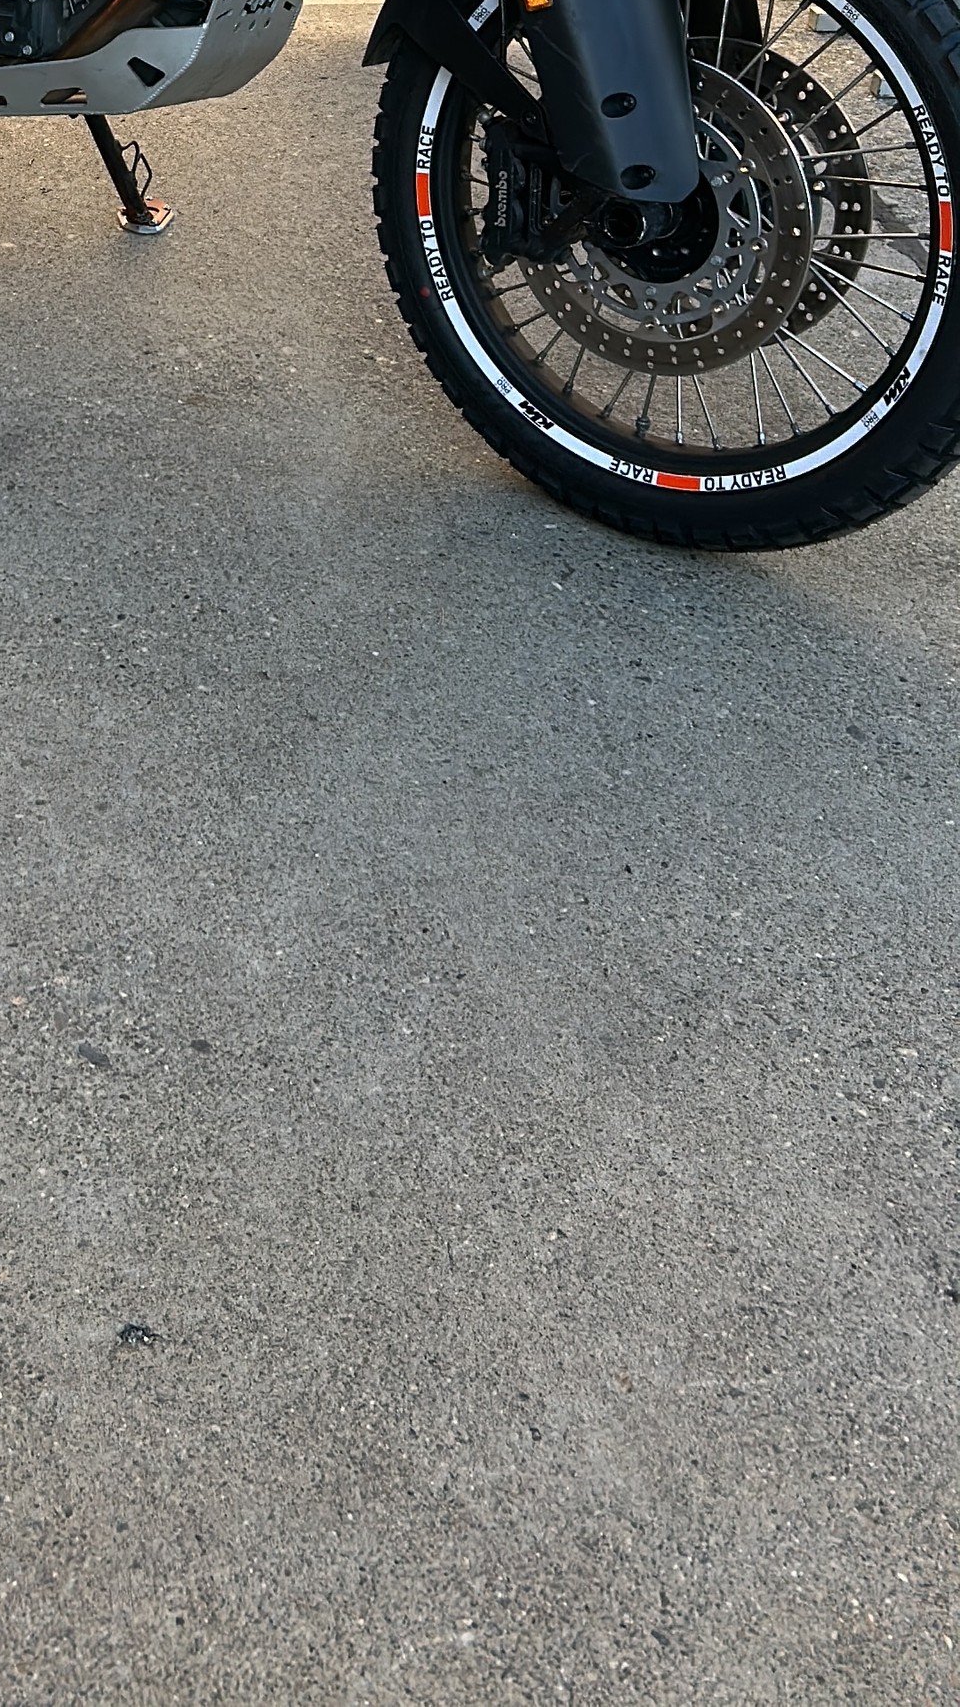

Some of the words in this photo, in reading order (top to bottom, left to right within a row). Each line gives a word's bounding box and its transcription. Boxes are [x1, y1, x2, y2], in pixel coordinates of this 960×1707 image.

[474, 7, 488, 22] PRO
[843, 4, 859, 21] PRO
[417, 125, 436, 169] RACE
[912, 104, 945, 165] READY
[494, 170, 508, 227] brembo
[935, 174, 951, 198] TO
[420, 219, 437, 241] TO
[424, 245, 456, 302] READY
[932, 253, 952, 307] RACE
[496, 378, 511, 394] PRO
[883, 366, 911, 407] KTM
[518, 400, 555, 430] KTM
[863, 412, 879, 428] PRO
[608, 456, 654, 484] RACE
[704, 476, 726, 492] TO
[730, 464, 788, 492] READY
